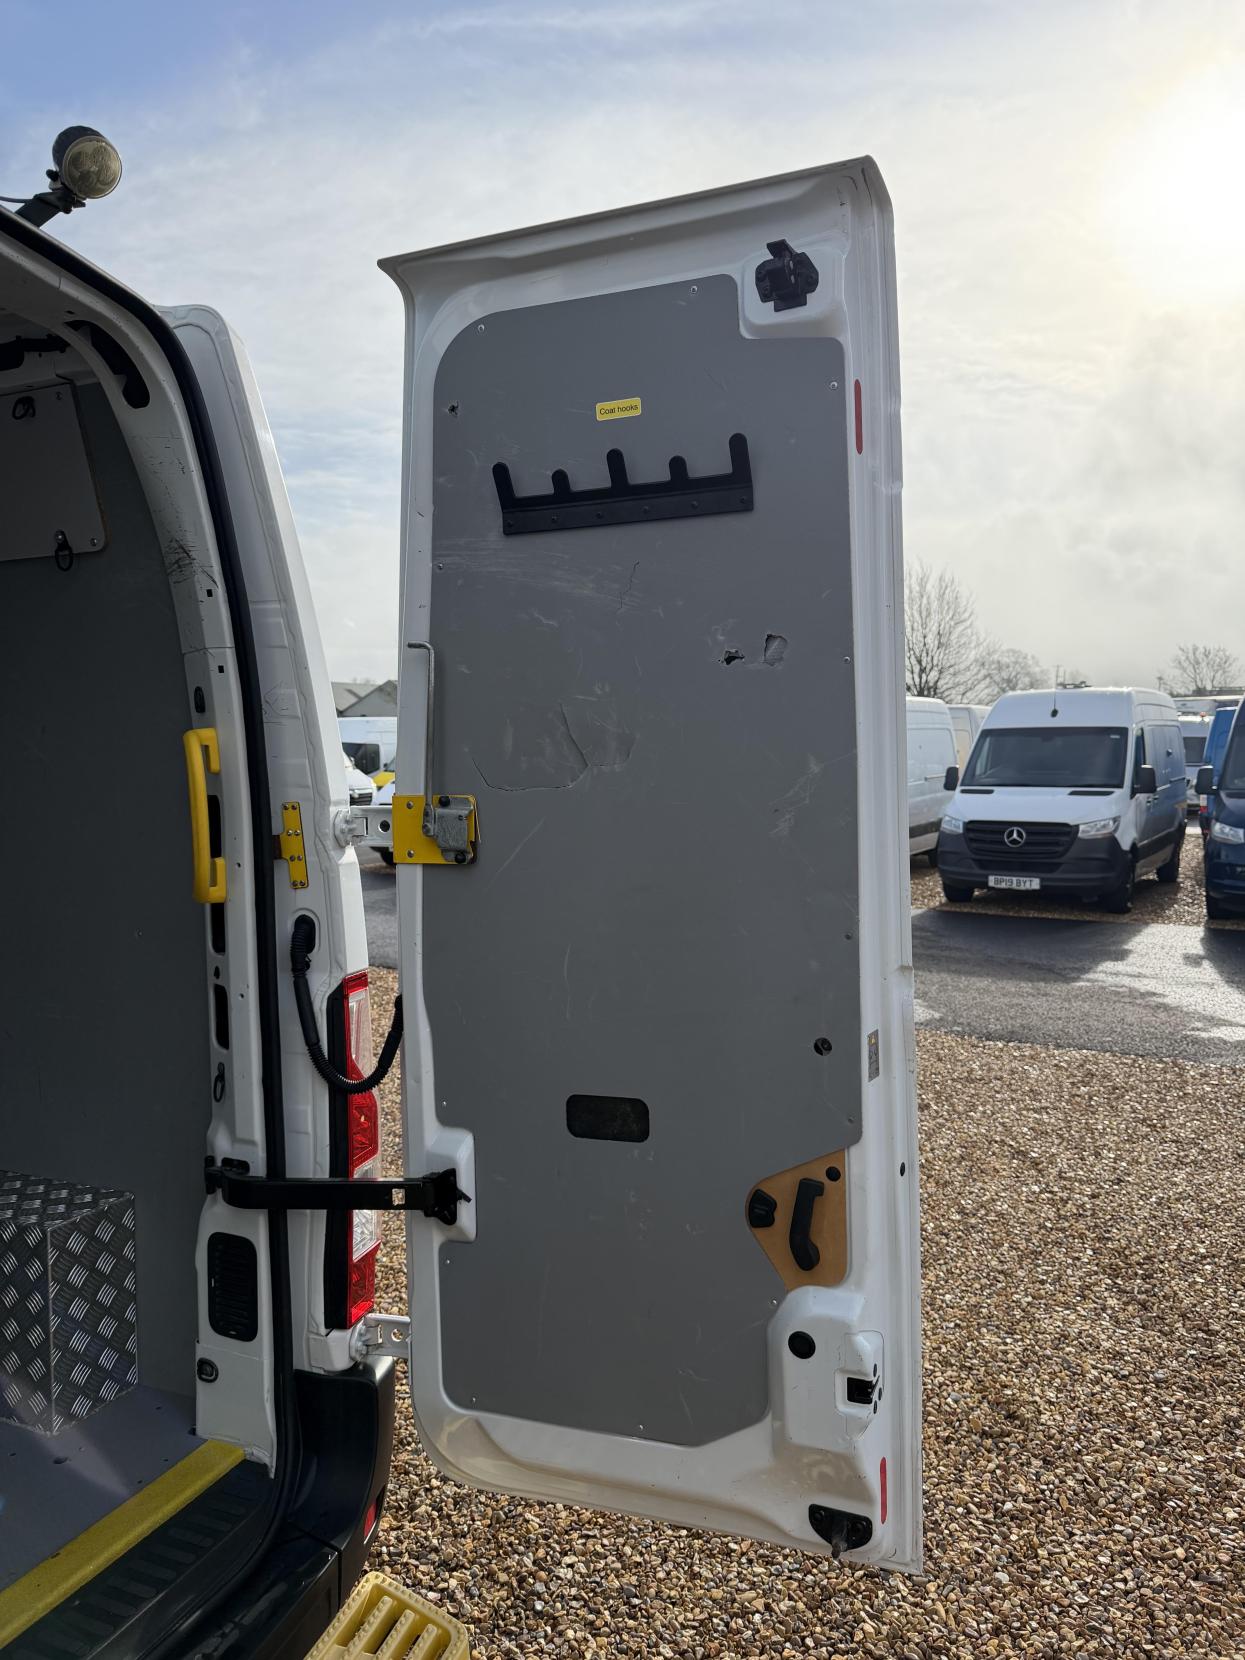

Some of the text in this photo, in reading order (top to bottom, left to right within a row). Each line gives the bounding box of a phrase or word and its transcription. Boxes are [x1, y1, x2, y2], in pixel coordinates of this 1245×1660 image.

[600, 404, 638, 415] Coat hooks
[994, 877, 1033, 888] BP19 BYT
